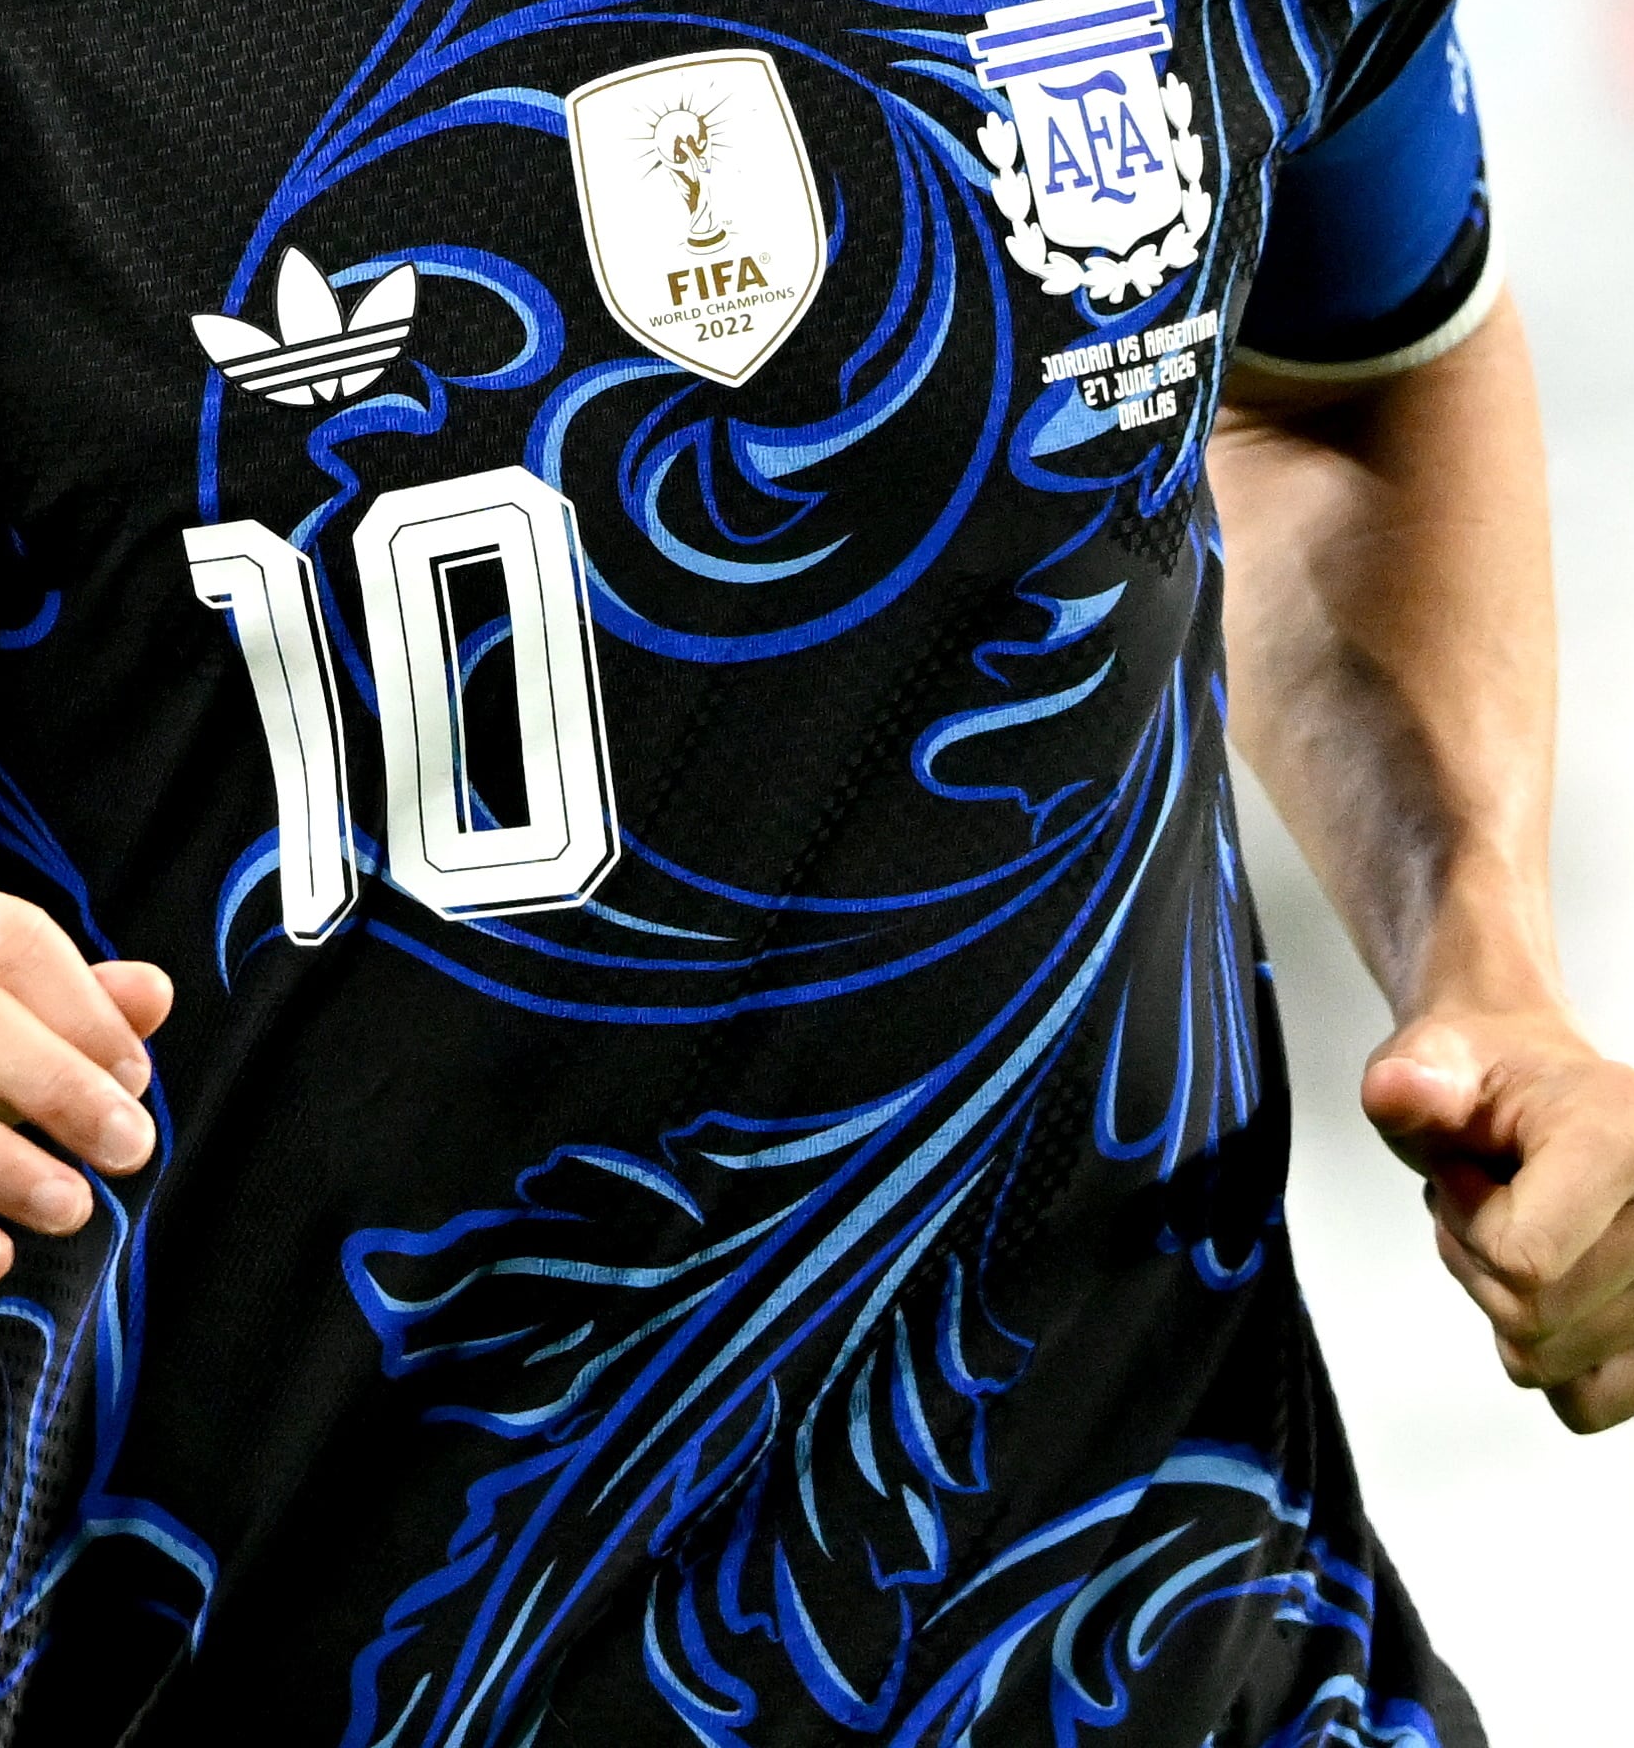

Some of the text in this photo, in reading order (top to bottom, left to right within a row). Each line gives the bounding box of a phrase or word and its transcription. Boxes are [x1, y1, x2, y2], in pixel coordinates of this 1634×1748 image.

[1038, 70, 1164, 204] AFA
[649, 287, 796, 327] WORLD CHAMPIONS
[667, 256, 768, 306] FIFA
[695, 313, 754, 342] 2022
[1041, 309, 1219, 384] JORDAN VS ARGENTINA
[1082, 351, 1197, 406] 27 JUNE 2026
[1118, 390, 1178, 431] DALLAS
[182, 465, 622, 946] 10
